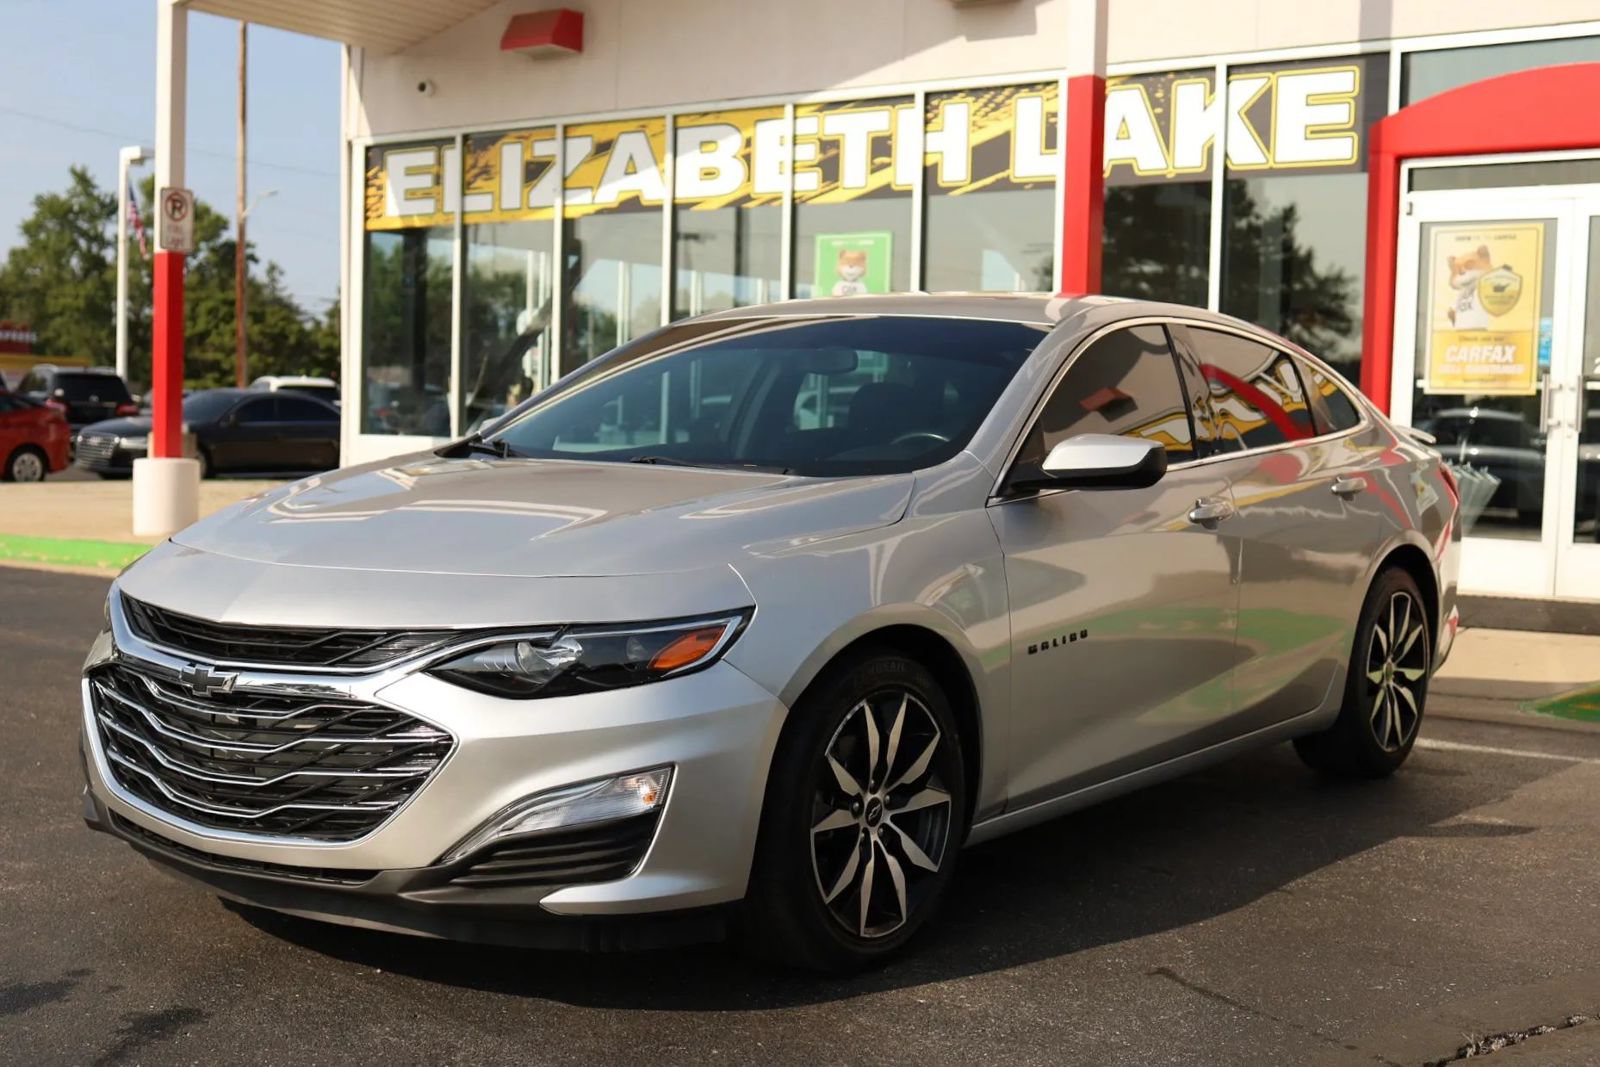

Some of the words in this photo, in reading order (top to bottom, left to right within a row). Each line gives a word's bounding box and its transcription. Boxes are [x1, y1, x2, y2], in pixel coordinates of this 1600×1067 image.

[385, 95, 972, 218] ELIZABETH
[1010, 65, 1360, 180] LAKE
[1445, 344, 1517, 363] CARFAX
[1028, 629, 1088, 655] MALIBU
